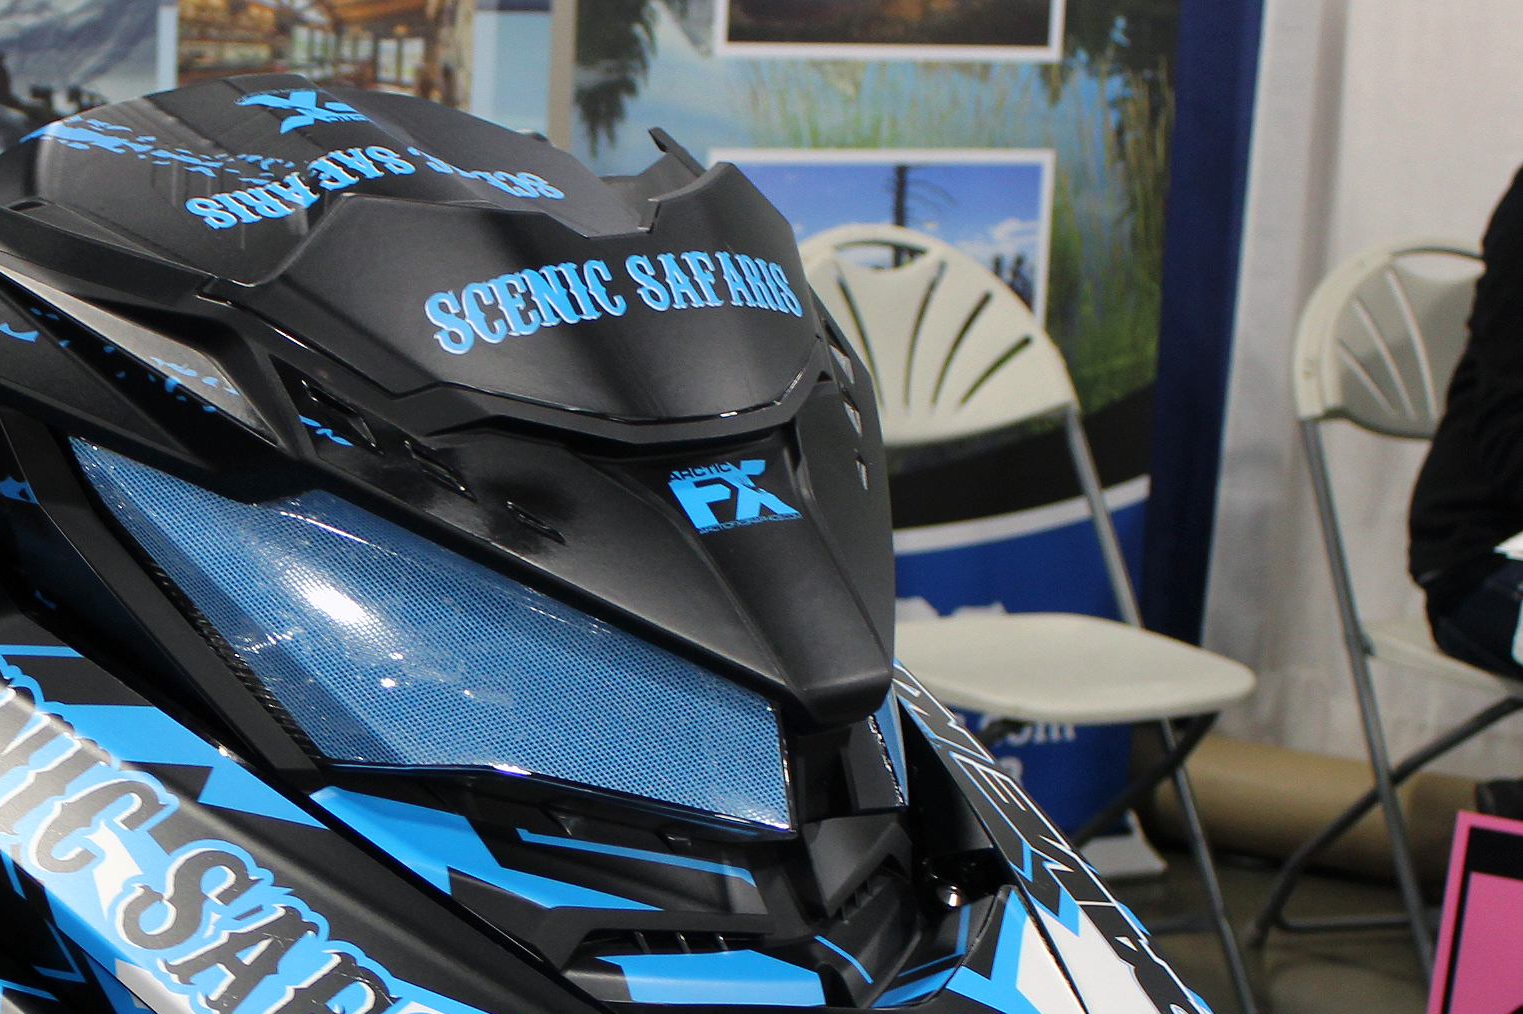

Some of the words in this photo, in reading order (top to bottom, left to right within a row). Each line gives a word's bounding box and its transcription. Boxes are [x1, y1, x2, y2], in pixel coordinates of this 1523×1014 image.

[424, 258, 628, 356] SCENIC
[625, 250, 804, 318] SAFARIS
[668, 461, 732, 482] ARCTIC
[668, 459, 800, 530] FX
